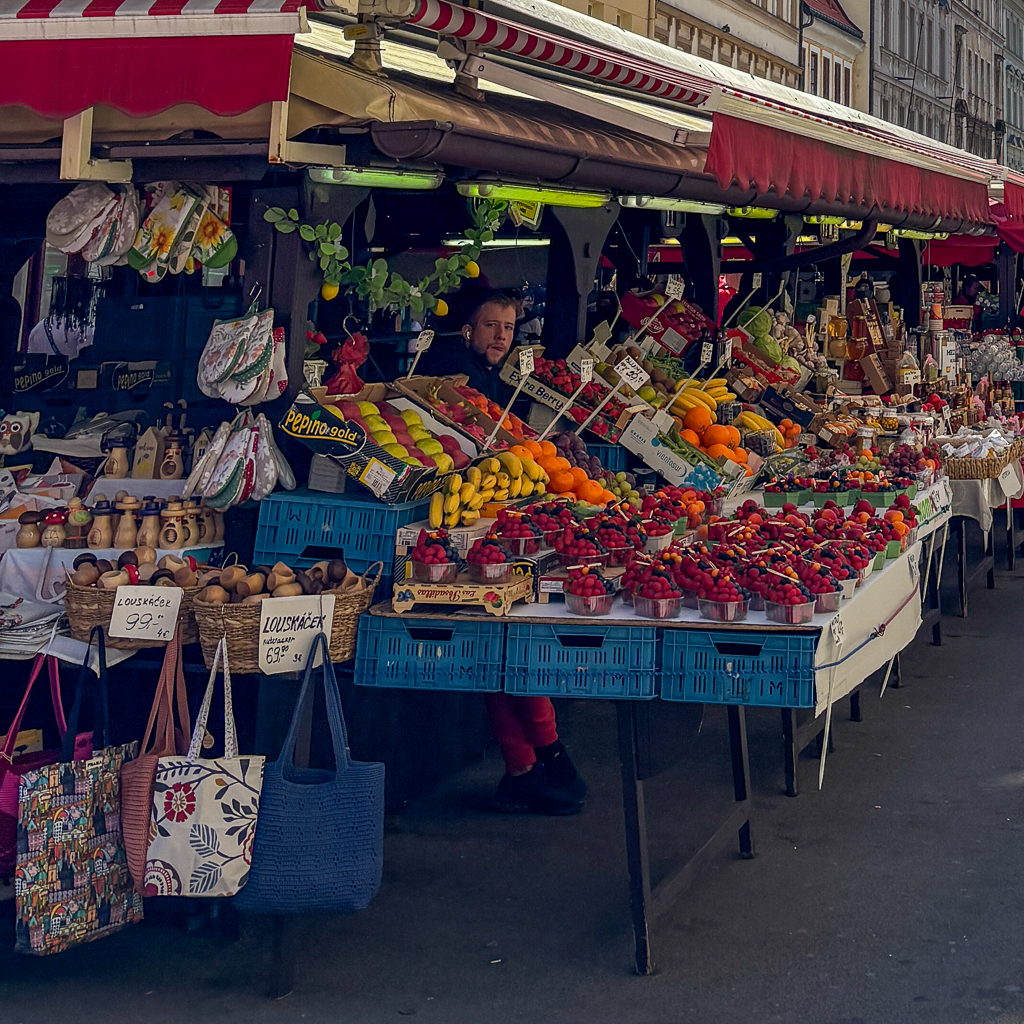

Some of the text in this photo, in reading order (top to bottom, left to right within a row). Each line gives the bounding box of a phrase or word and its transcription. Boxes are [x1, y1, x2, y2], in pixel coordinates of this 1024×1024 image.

[509, 370, 564, 410] Exra Berry
[329, 426, 358, 442] gold
